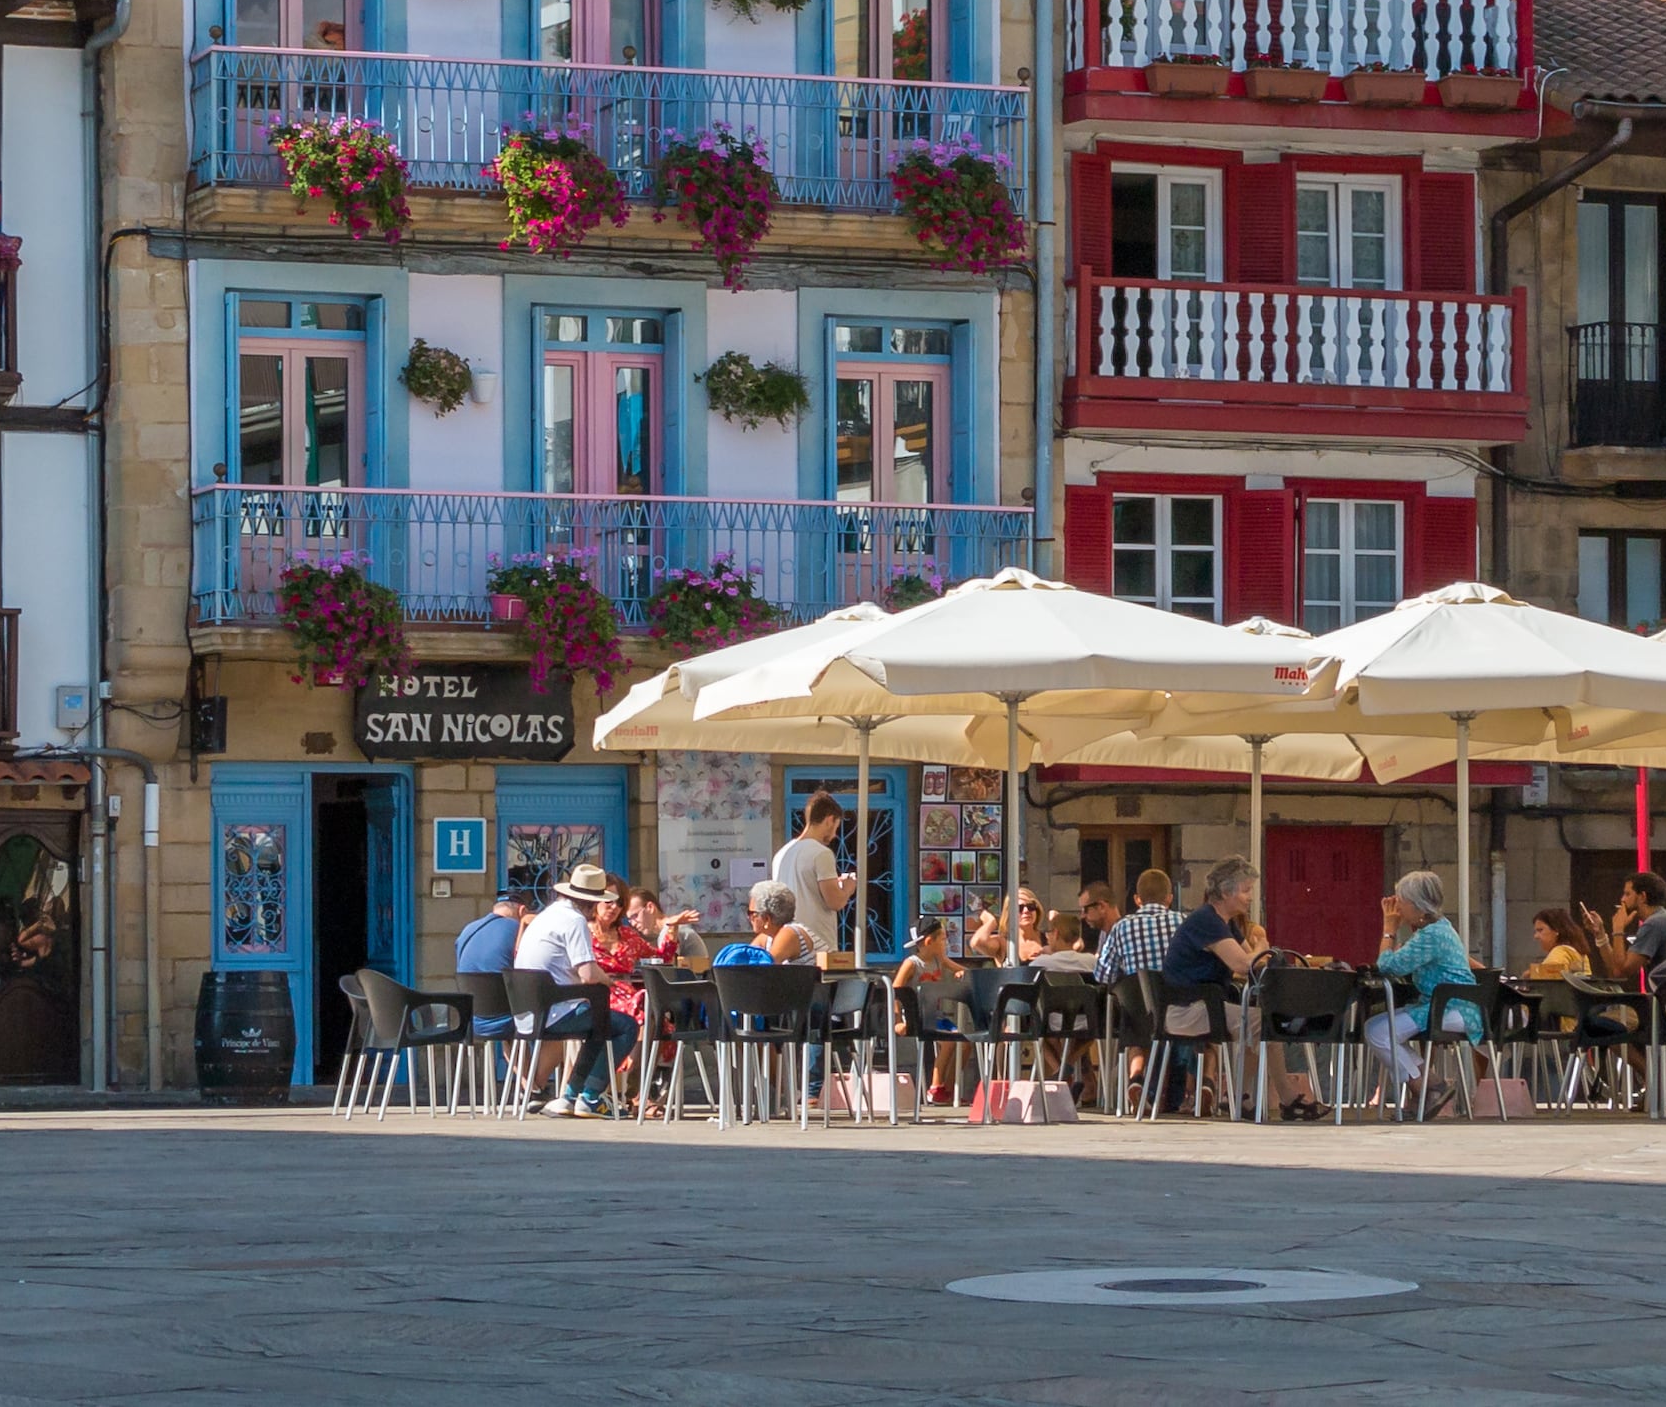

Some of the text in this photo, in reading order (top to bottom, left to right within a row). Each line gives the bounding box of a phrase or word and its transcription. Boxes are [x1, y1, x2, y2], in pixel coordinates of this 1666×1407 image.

[1275, 667, 1309, 680] Mah
[378, 675, 478, 698] HOTEL
[365, 713, 432, 742] SAN
[449, 829, 471, 856] H
